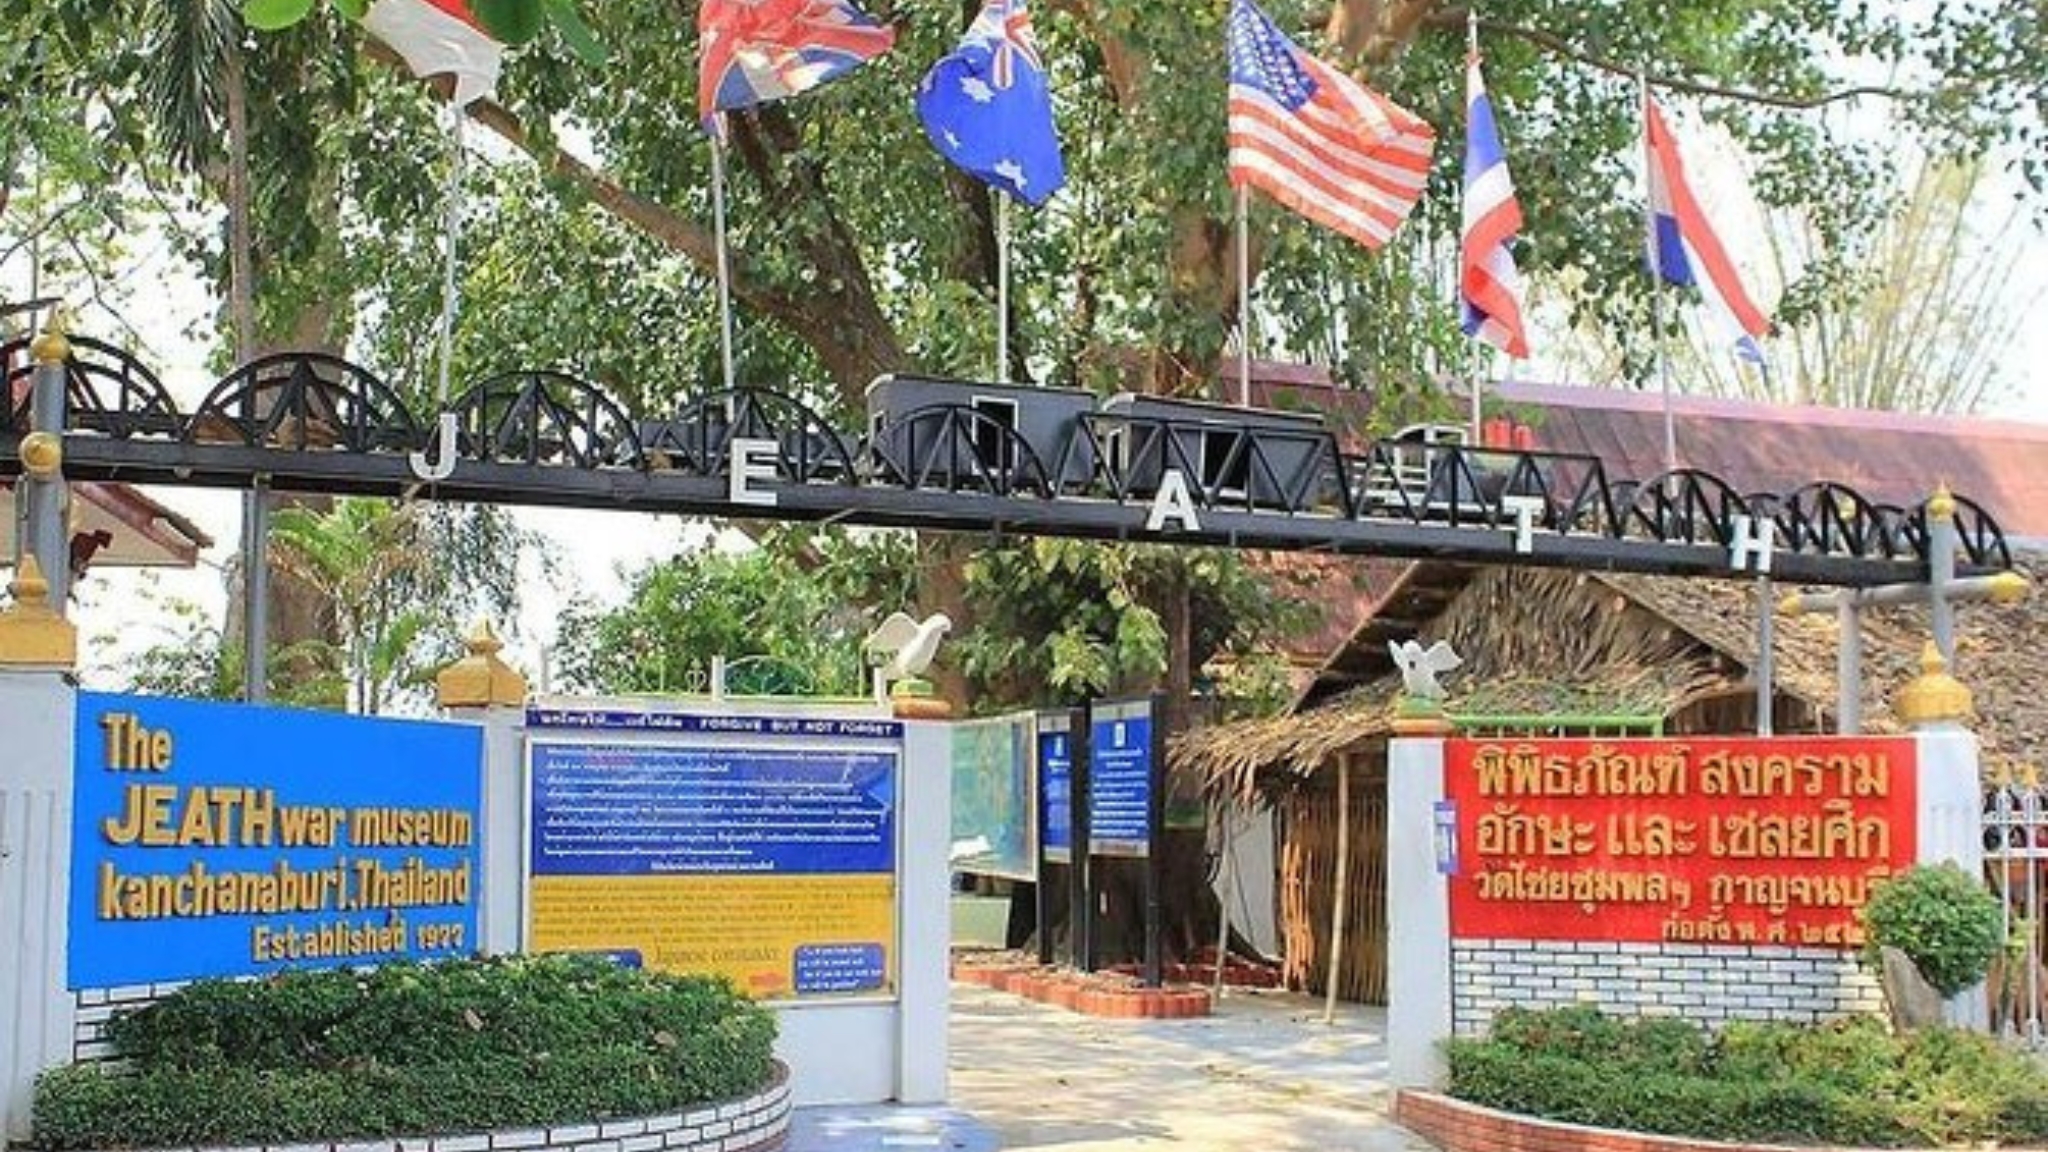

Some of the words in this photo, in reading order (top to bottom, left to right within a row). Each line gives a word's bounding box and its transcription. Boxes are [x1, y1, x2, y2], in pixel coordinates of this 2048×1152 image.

[409, 412, 459, 481] J
[729, 438, 777, 507] E
[1146, 469, 1201, 533] A
[1502, 496, 1546, 554] T
[1731, 515, 1774, 571] H
[101, 714, 171, 772] The
[772, 719, 799, 732] BUT
[805, 721, 834, 734] NOT
[840, 722, 893, 736] FORGET
[1700, 750, 1890, 797] สงคราม
[105, 784, 275, 848] JEATH
[280, 808, 345, 847] war
[352, 809, 472, 848] museum
[1476, 801, 1596, 856] อักษะ
[1708, 797, 1891, 860] เชลยศึก
[251, 910, 407, 963] Established
[418, 924, 464, 949] 1977
